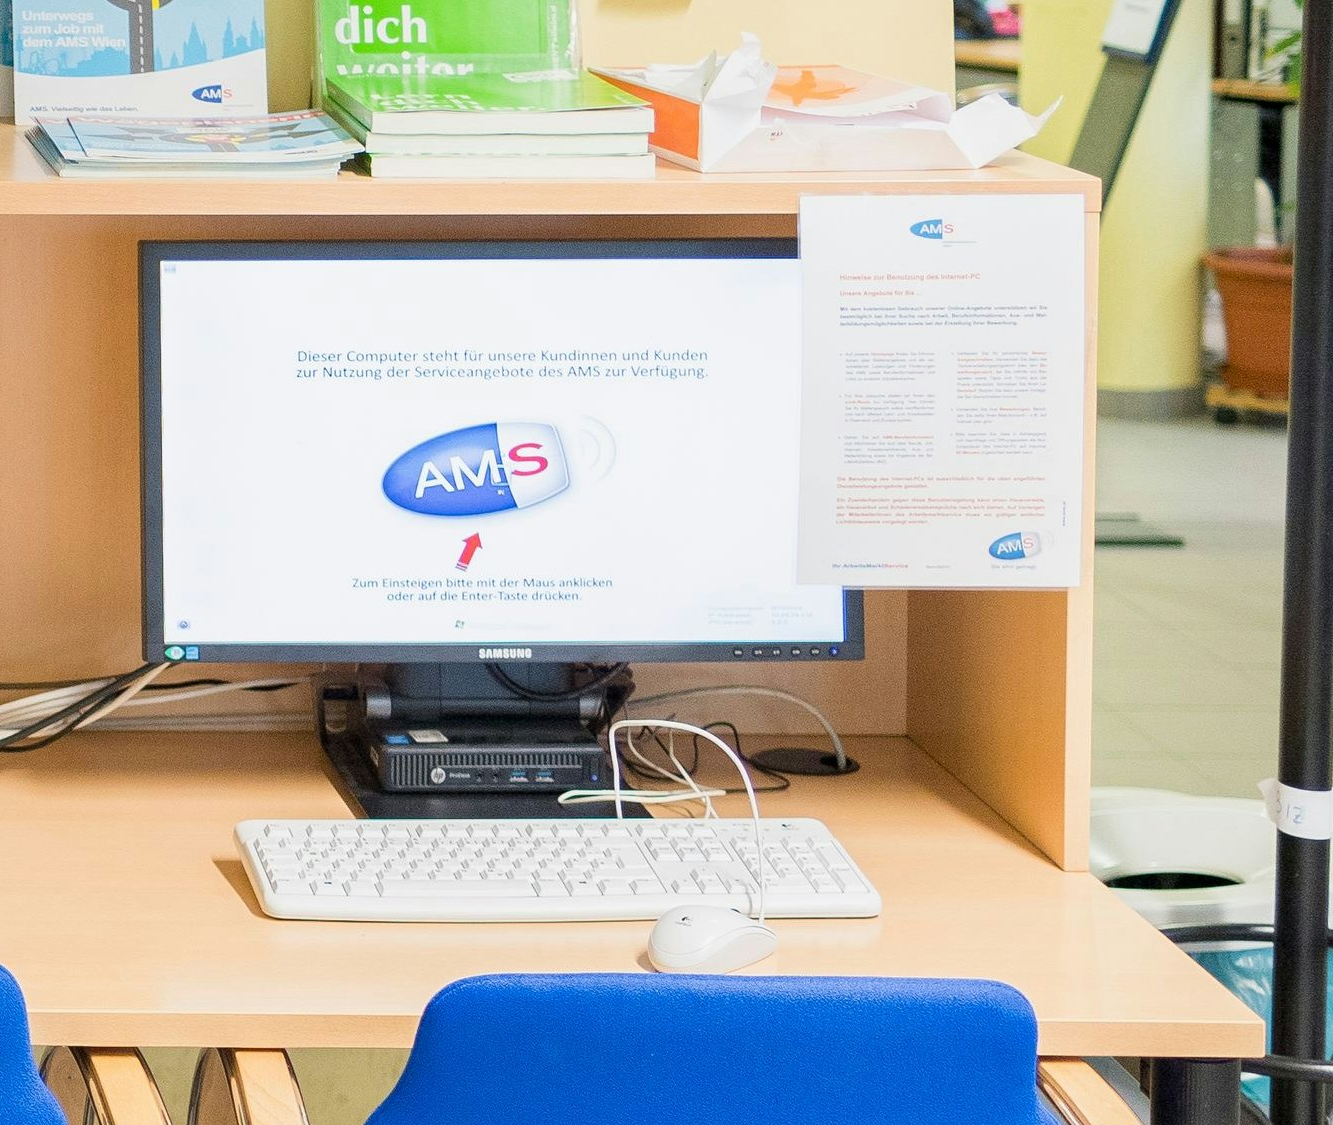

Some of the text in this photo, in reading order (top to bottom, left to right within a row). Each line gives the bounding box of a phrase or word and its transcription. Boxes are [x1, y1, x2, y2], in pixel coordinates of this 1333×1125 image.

[21, 10, 94, 25] Unterwegs
[21, 23, 104, 34] zum Job mit
[335, 4, 428, 45] dich
[22, 37, 126, 48] dem AMS Wien
[200, 88, 233, 99] AMS
[919, 223, 954, 234] AMS
[297, 350, 708, 366] Dieser Computer steht für unsere Kundinnen und Kunden
[296, 365, 709, 380] zur Nutzung der Serviceangebote des AMS zur Verfügung.
[415, 442, 549, 499] AMS
[996, 536, 1034, 555] AMS
[352, 578, 613, 590] Zum Einsteigen bitte mit der Maus anklicken
[387, 590, 582, 601] oder auf die Enter-Taste drücken.
[478, 648, 533, 659] SAMSUNG
